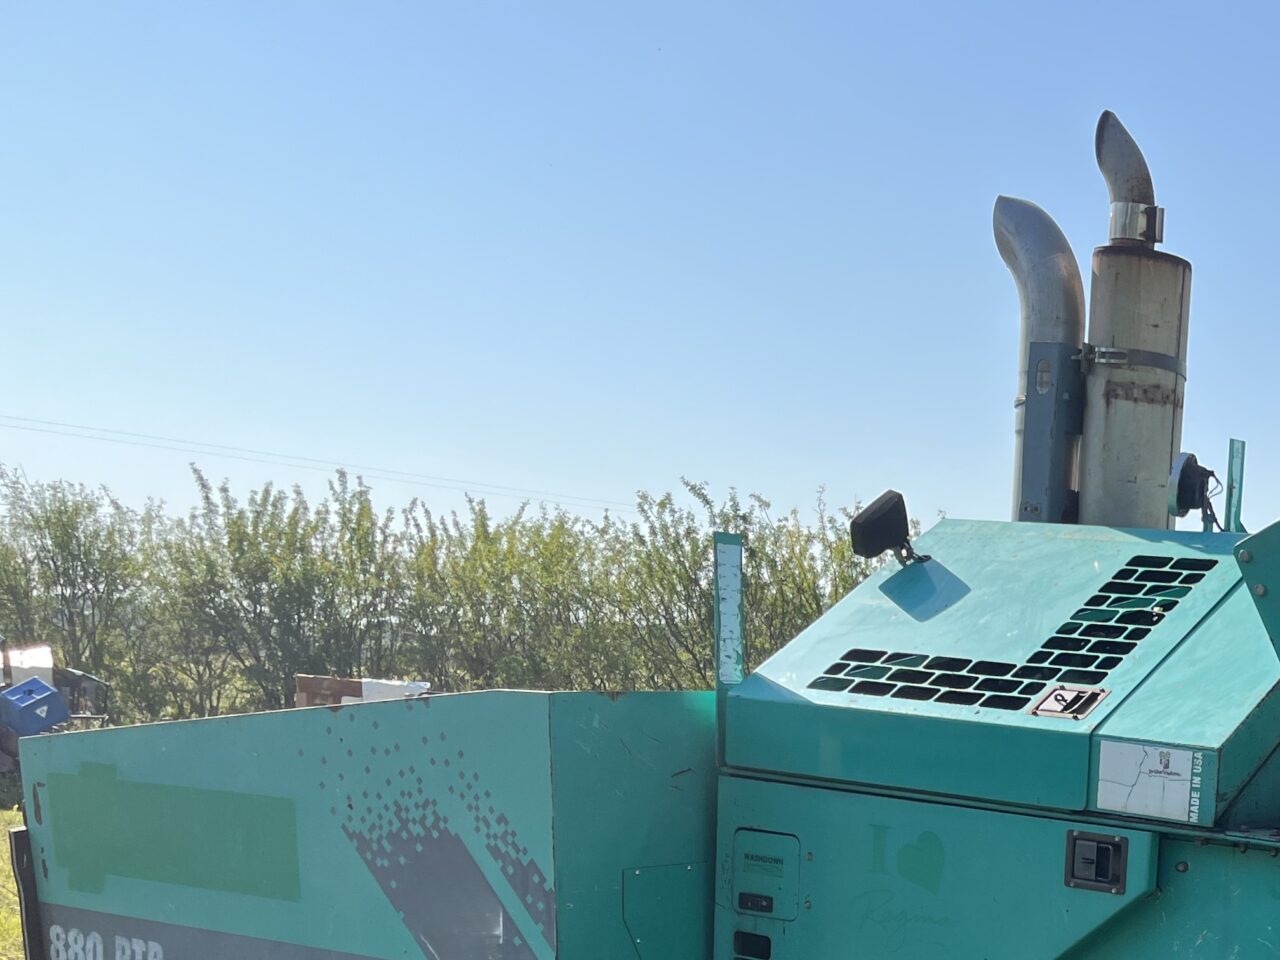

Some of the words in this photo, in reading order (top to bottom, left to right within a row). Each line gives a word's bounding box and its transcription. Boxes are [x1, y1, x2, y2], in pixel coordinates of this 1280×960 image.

[1193, 752, 1203, 773] USA
[1191, 776, 1202, 788] IN
[1189, 791, 1200, 823] MADE
